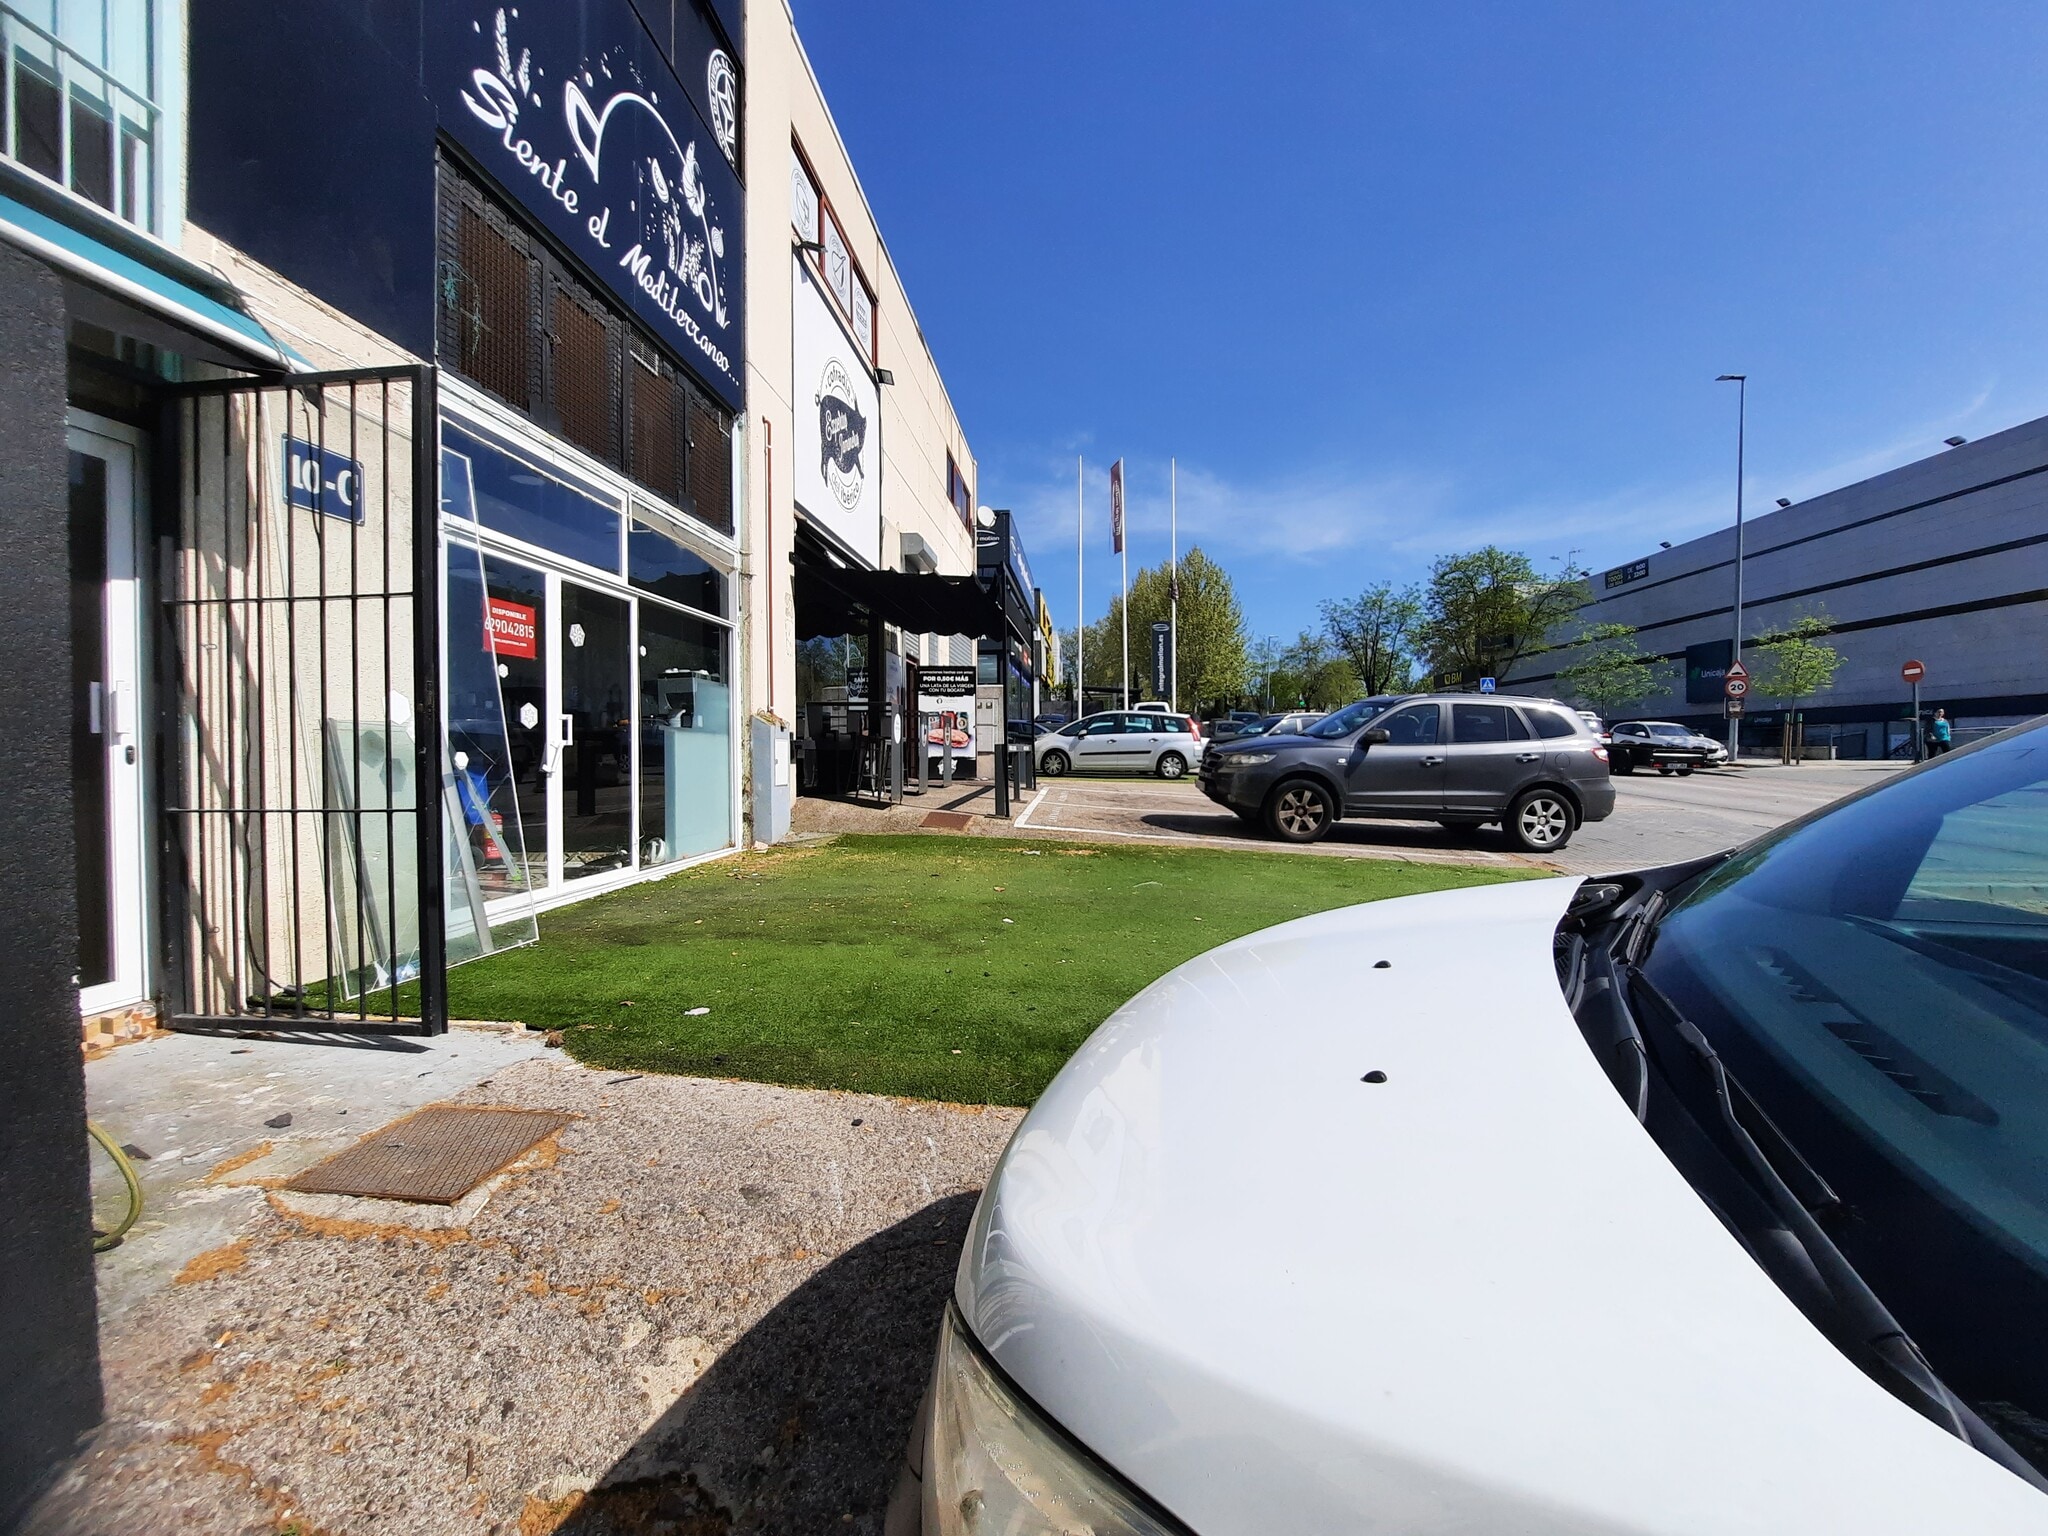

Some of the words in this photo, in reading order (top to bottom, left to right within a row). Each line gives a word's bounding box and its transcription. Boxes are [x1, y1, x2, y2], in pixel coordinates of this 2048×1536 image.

[461, 69, 579, 214] Siente
[588, 207, 611, 248] el
[492, 607, 527, 620] DISPONIBLE
[485, 617, 535, 639] 629042815
[955, 674, 969, 682] MÁS
[1701, 668, 1726, 678] Unicaja
[1730, 683, 1744, 691] 20
